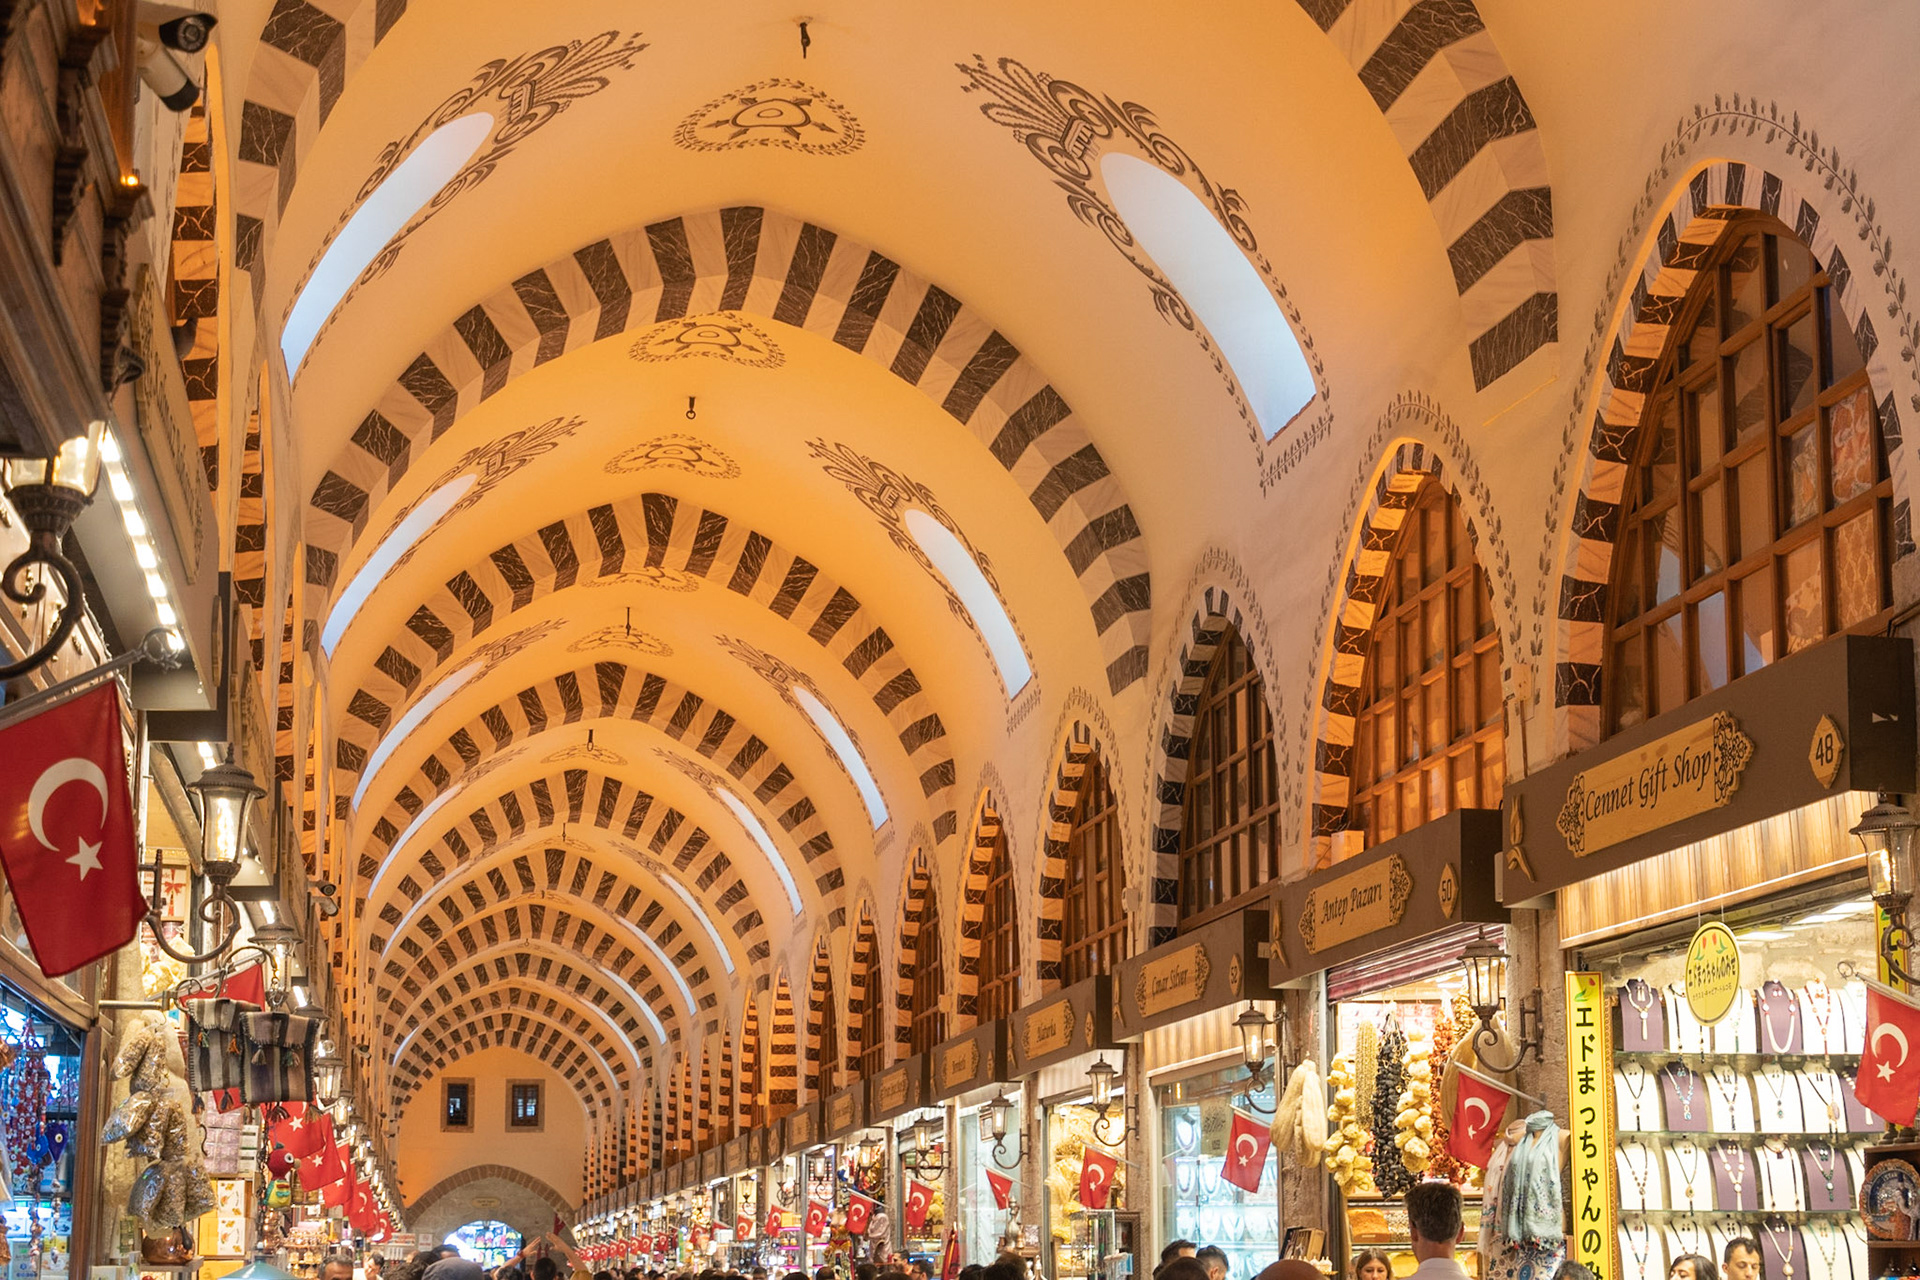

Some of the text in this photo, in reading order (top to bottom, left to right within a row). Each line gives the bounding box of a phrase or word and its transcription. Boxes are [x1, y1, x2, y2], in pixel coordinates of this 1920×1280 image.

[1815, 732, 1833, 766] 48
[1585, 746, 1711, 821] Cennet Gift Shop
[1321, 883, 1382, 925] Antep Pazarı
[1441, 878, 1452, 902] 50
[1230, 965, 1238, 985] 52
